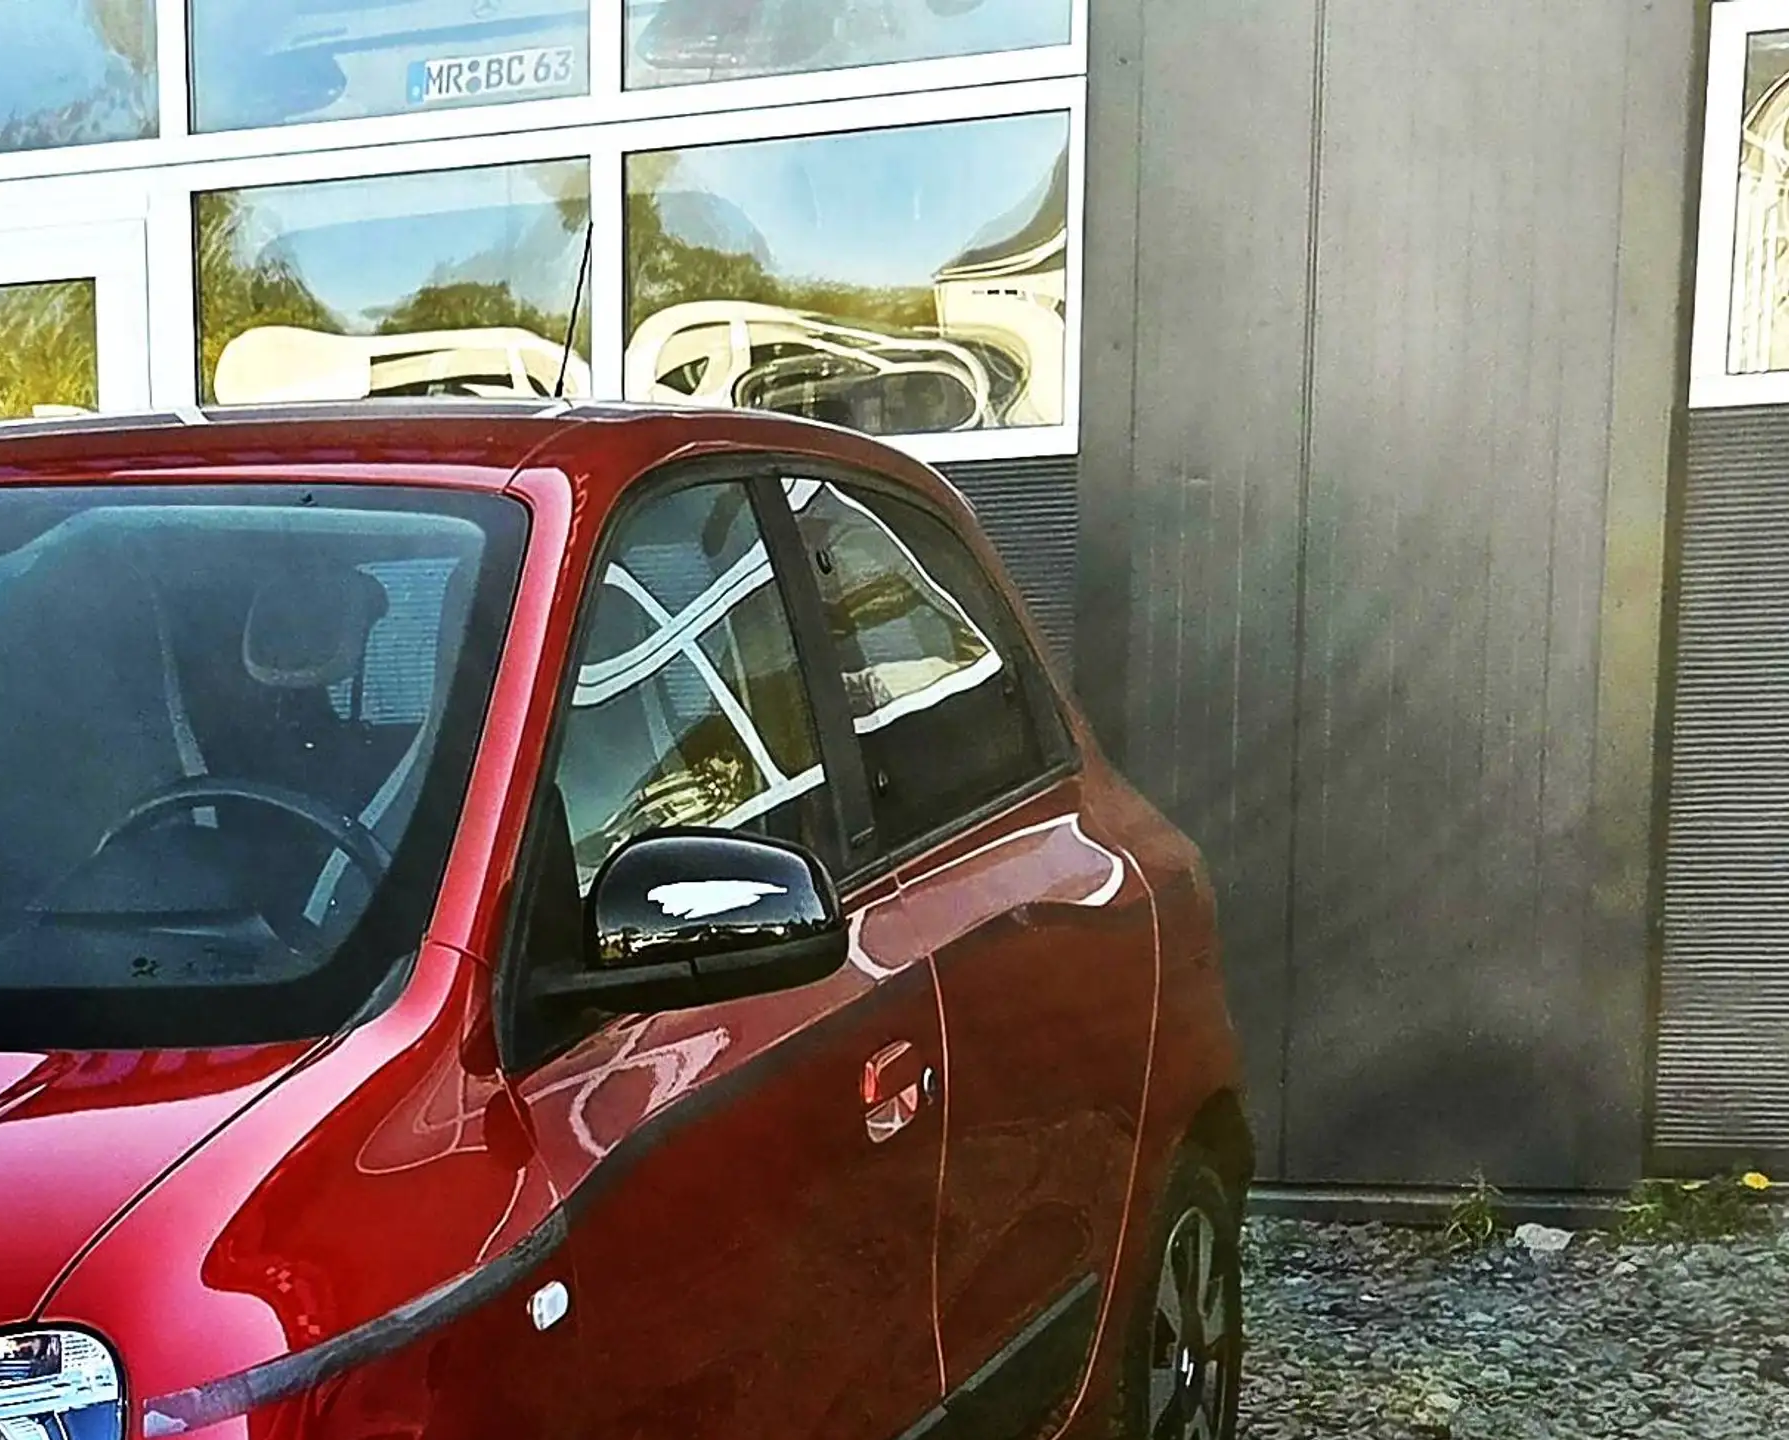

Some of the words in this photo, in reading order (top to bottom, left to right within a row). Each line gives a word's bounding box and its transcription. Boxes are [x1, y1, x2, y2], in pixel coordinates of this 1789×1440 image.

[425, 62, 463, 95] MR
[486, 54, 525, 90] BC
[534, 50, 573, 84] 63
